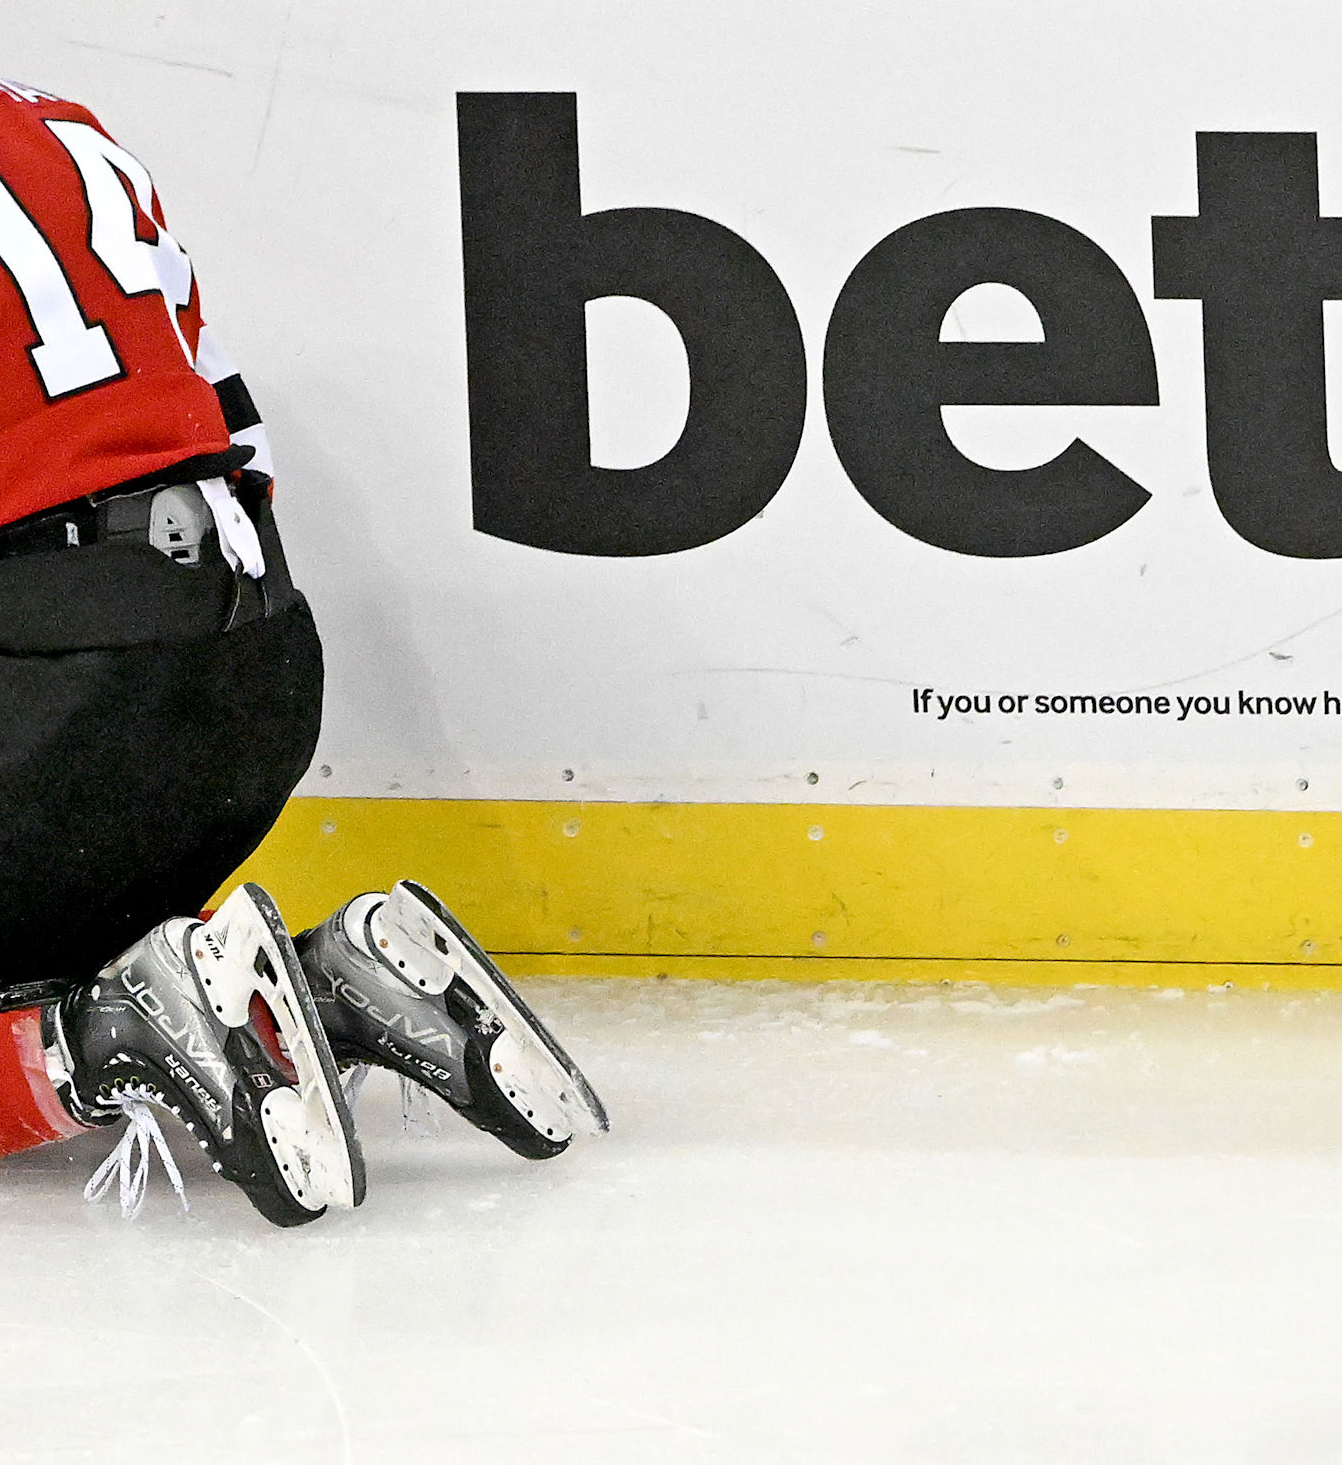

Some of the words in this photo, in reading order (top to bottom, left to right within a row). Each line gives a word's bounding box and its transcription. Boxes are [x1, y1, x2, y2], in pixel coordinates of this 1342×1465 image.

[456, 91, 1342, 560] bet
[913, 688, 933, 713] If
[936, 695, 991, 720] you
[998, 695, 1029, 714] or
[1034, 695, 1171, 715] someone
[1176, 696, 1230, 721] you
[1238, 690, 1317, 715] know
